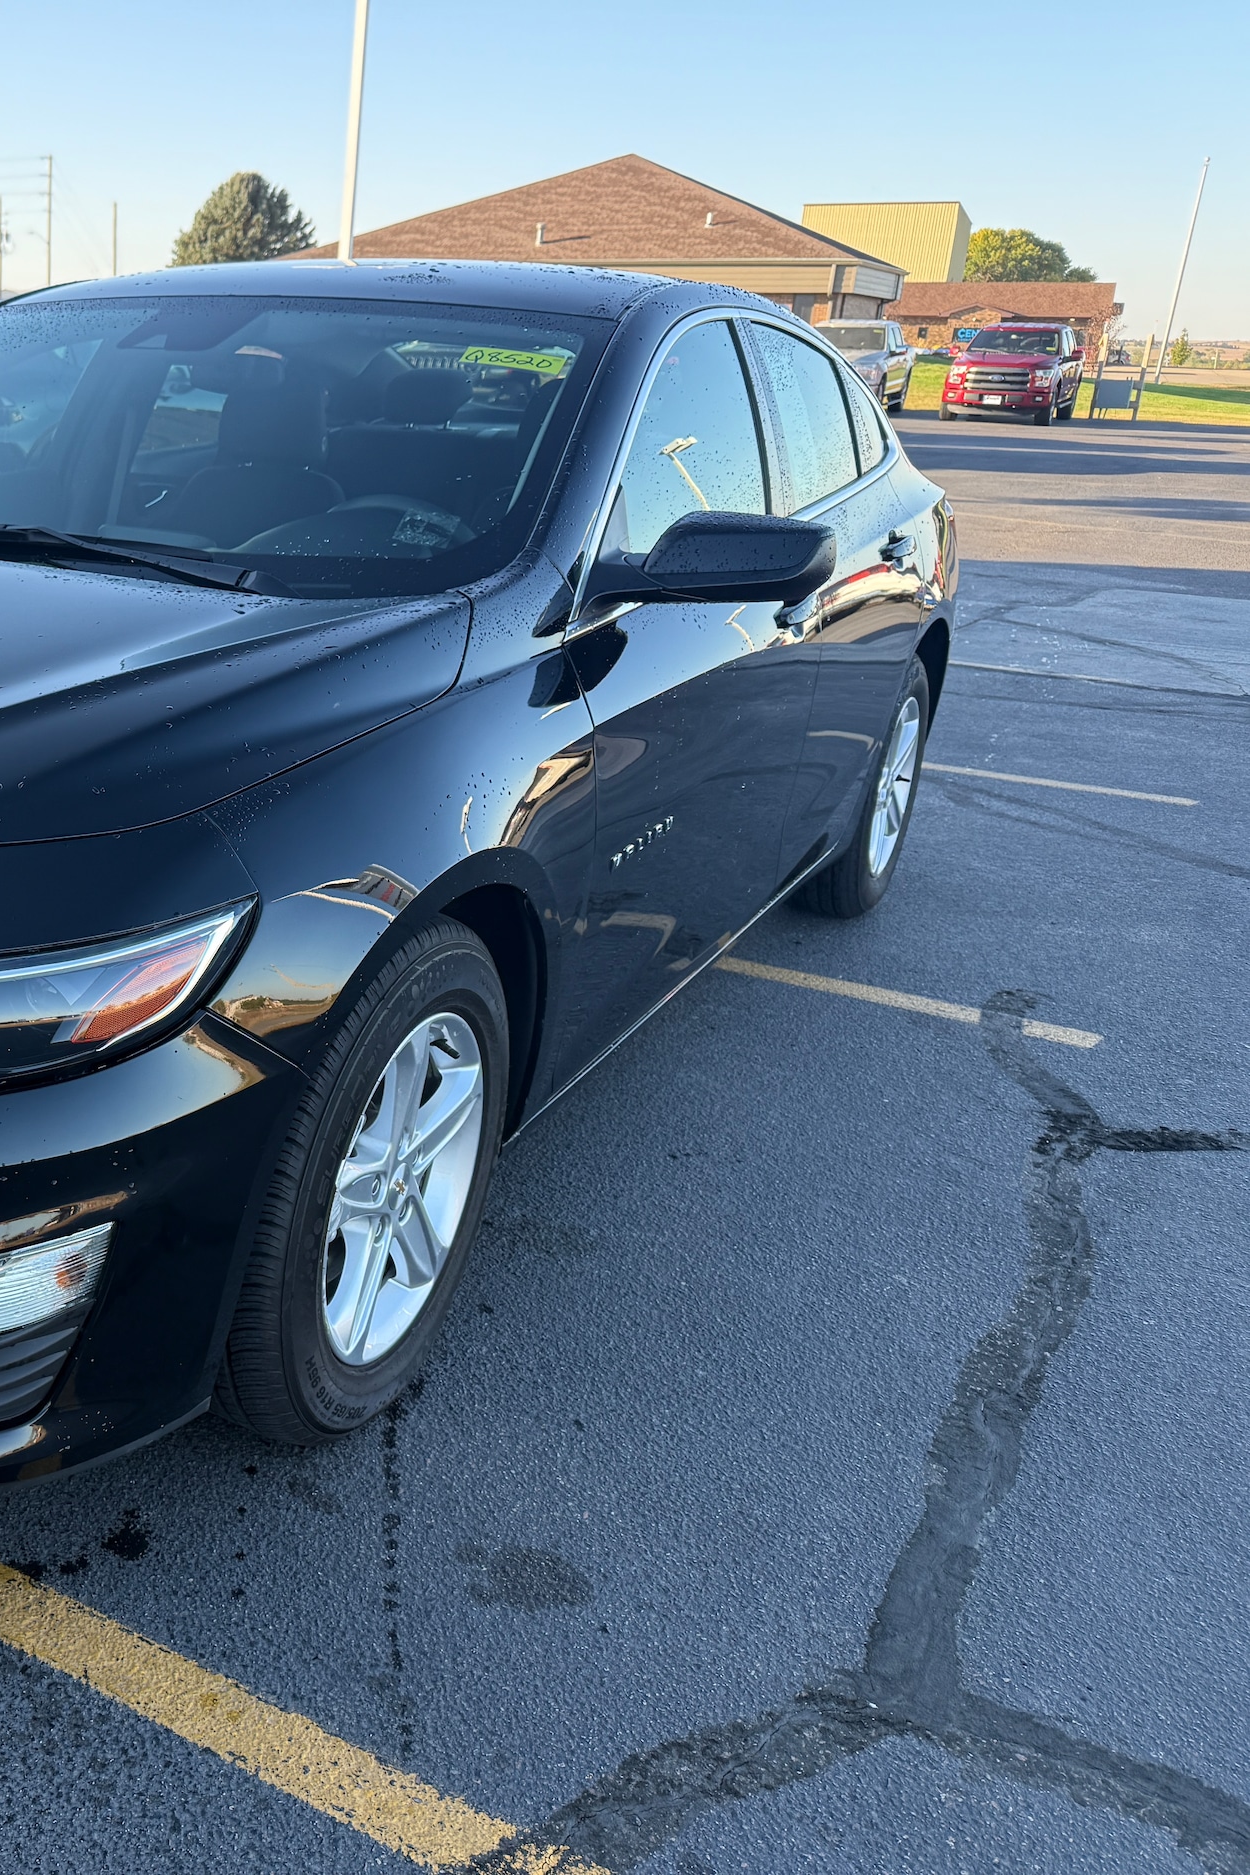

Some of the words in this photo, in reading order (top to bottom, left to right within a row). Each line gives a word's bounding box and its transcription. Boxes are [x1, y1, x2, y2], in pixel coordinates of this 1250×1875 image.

[957, 328, 979, 338] CEN
[305, 1355, 321, 1388] 95H
[315, 1386, 336, 1411] R16
[331, 1403, 367, 1419] 205/65
